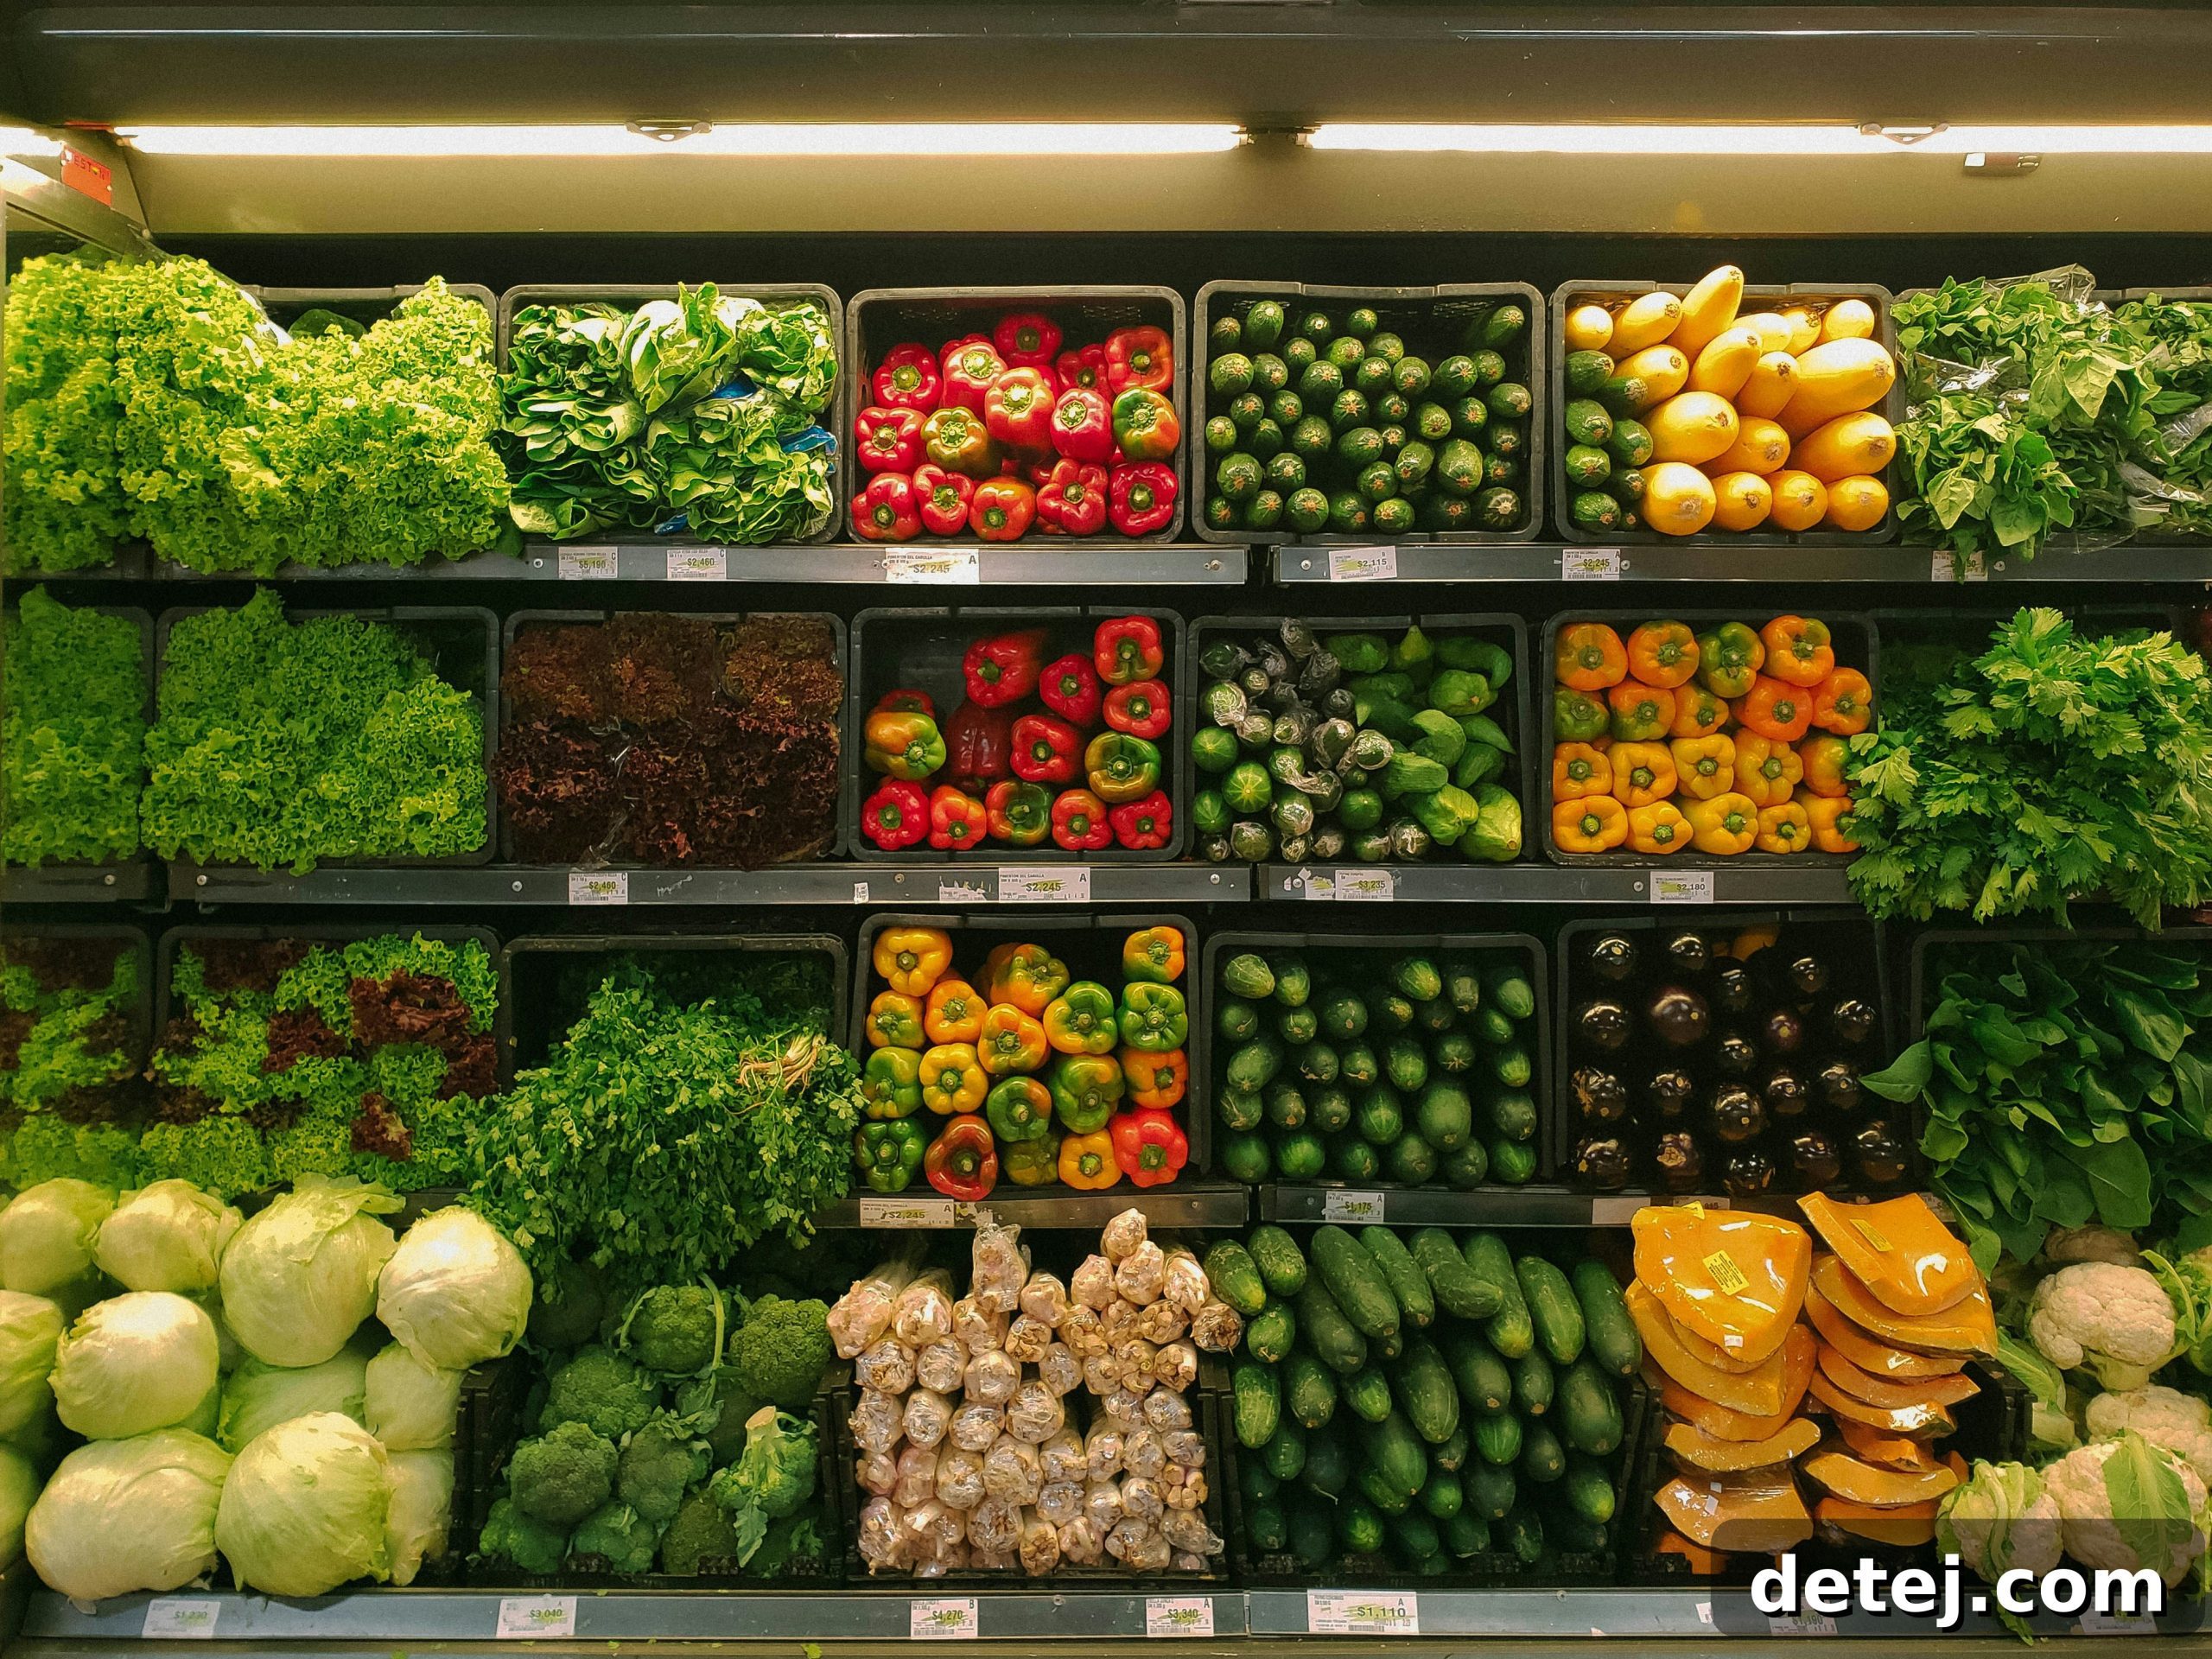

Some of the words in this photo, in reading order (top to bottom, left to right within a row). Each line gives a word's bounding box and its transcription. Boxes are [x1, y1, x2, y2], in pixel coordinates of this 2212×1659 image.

[720, 549, 725, 558] C
[578, 560, 607, 569] $5,190
[687, 557, 715, 568] $2,460
[969, 555, 977, 564] A
[1583, 558, 1610, 569] $2,245
[913, 564, 950, 574] $2245
[621, 873, 626, 881] C
[1079, 873, 1087, 882] A
[588, 881, 616, 891] $2,460
[1026, 882, 1061, 893] $2,245
[1358, 880, 1386, 890] $3,235
[1377, 1194, 1382, 1203] A
[888, 1211, 925, 1219] $2,245
[969, 1599, 975, 1609] B
[1204, 1598, 1210, 1608] A
[931, 1610, 963, 1622] $4,270
[1167, 1608, 1198, 1620] $3,340
[1357, 1606, 1406, 1618] $1,110
